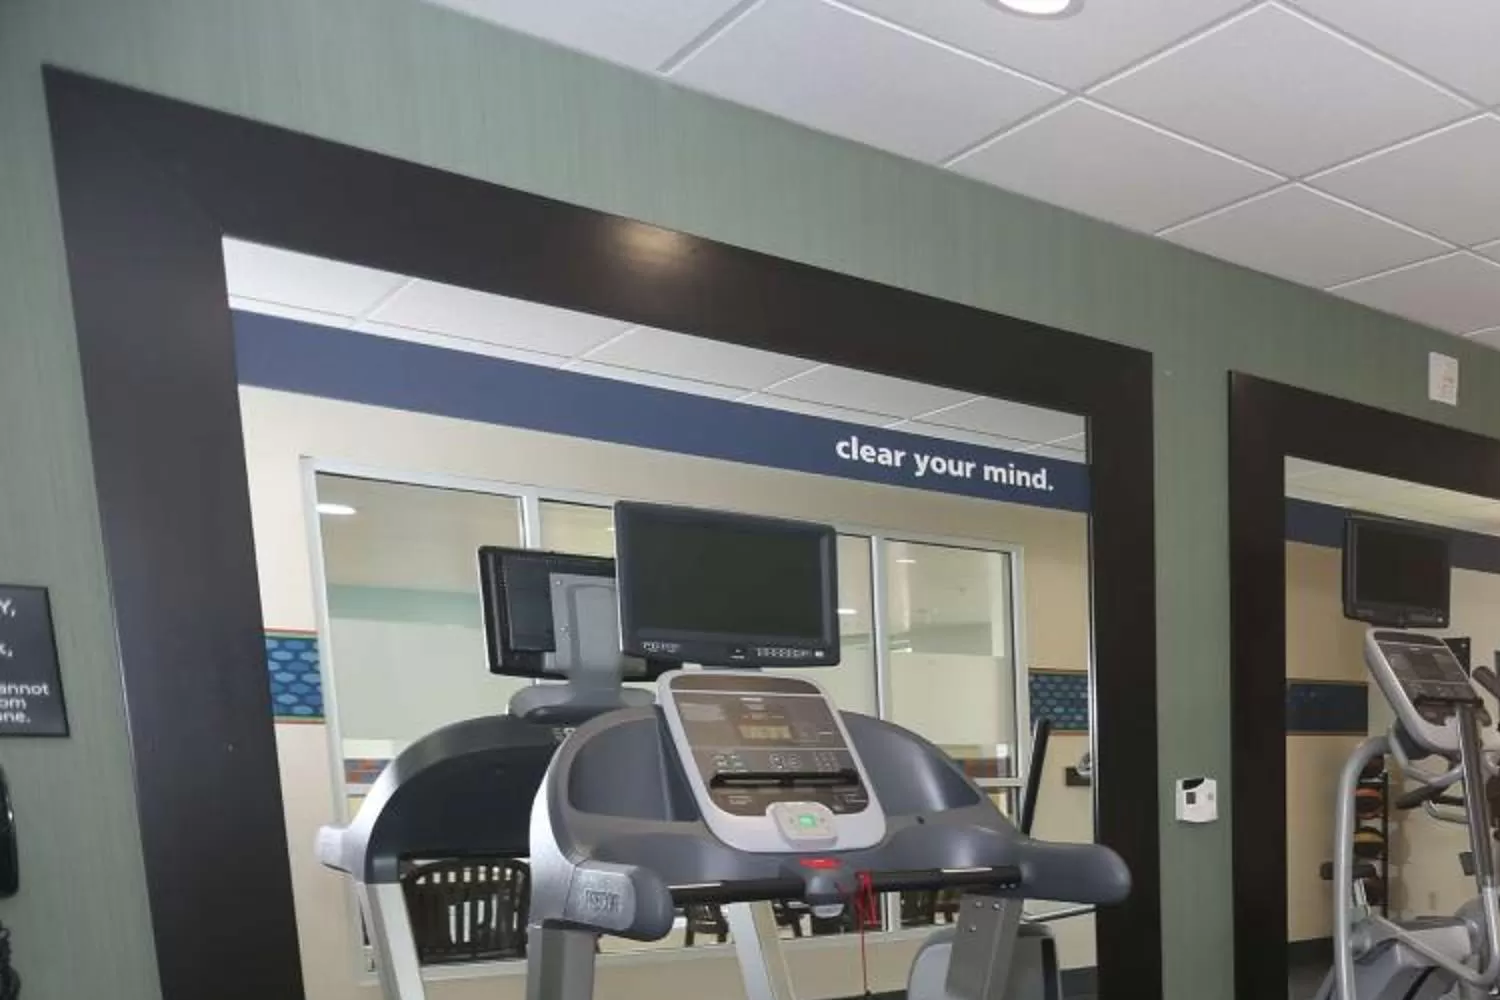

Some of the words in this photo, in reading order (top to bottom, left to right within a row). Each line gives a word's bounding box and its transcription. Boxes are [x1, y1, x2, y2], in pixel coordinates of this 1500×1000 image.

[835, 435, 907, 467] clear
[913, 452, 976, 478] your
[983, 463, 1055, 492] mind.
